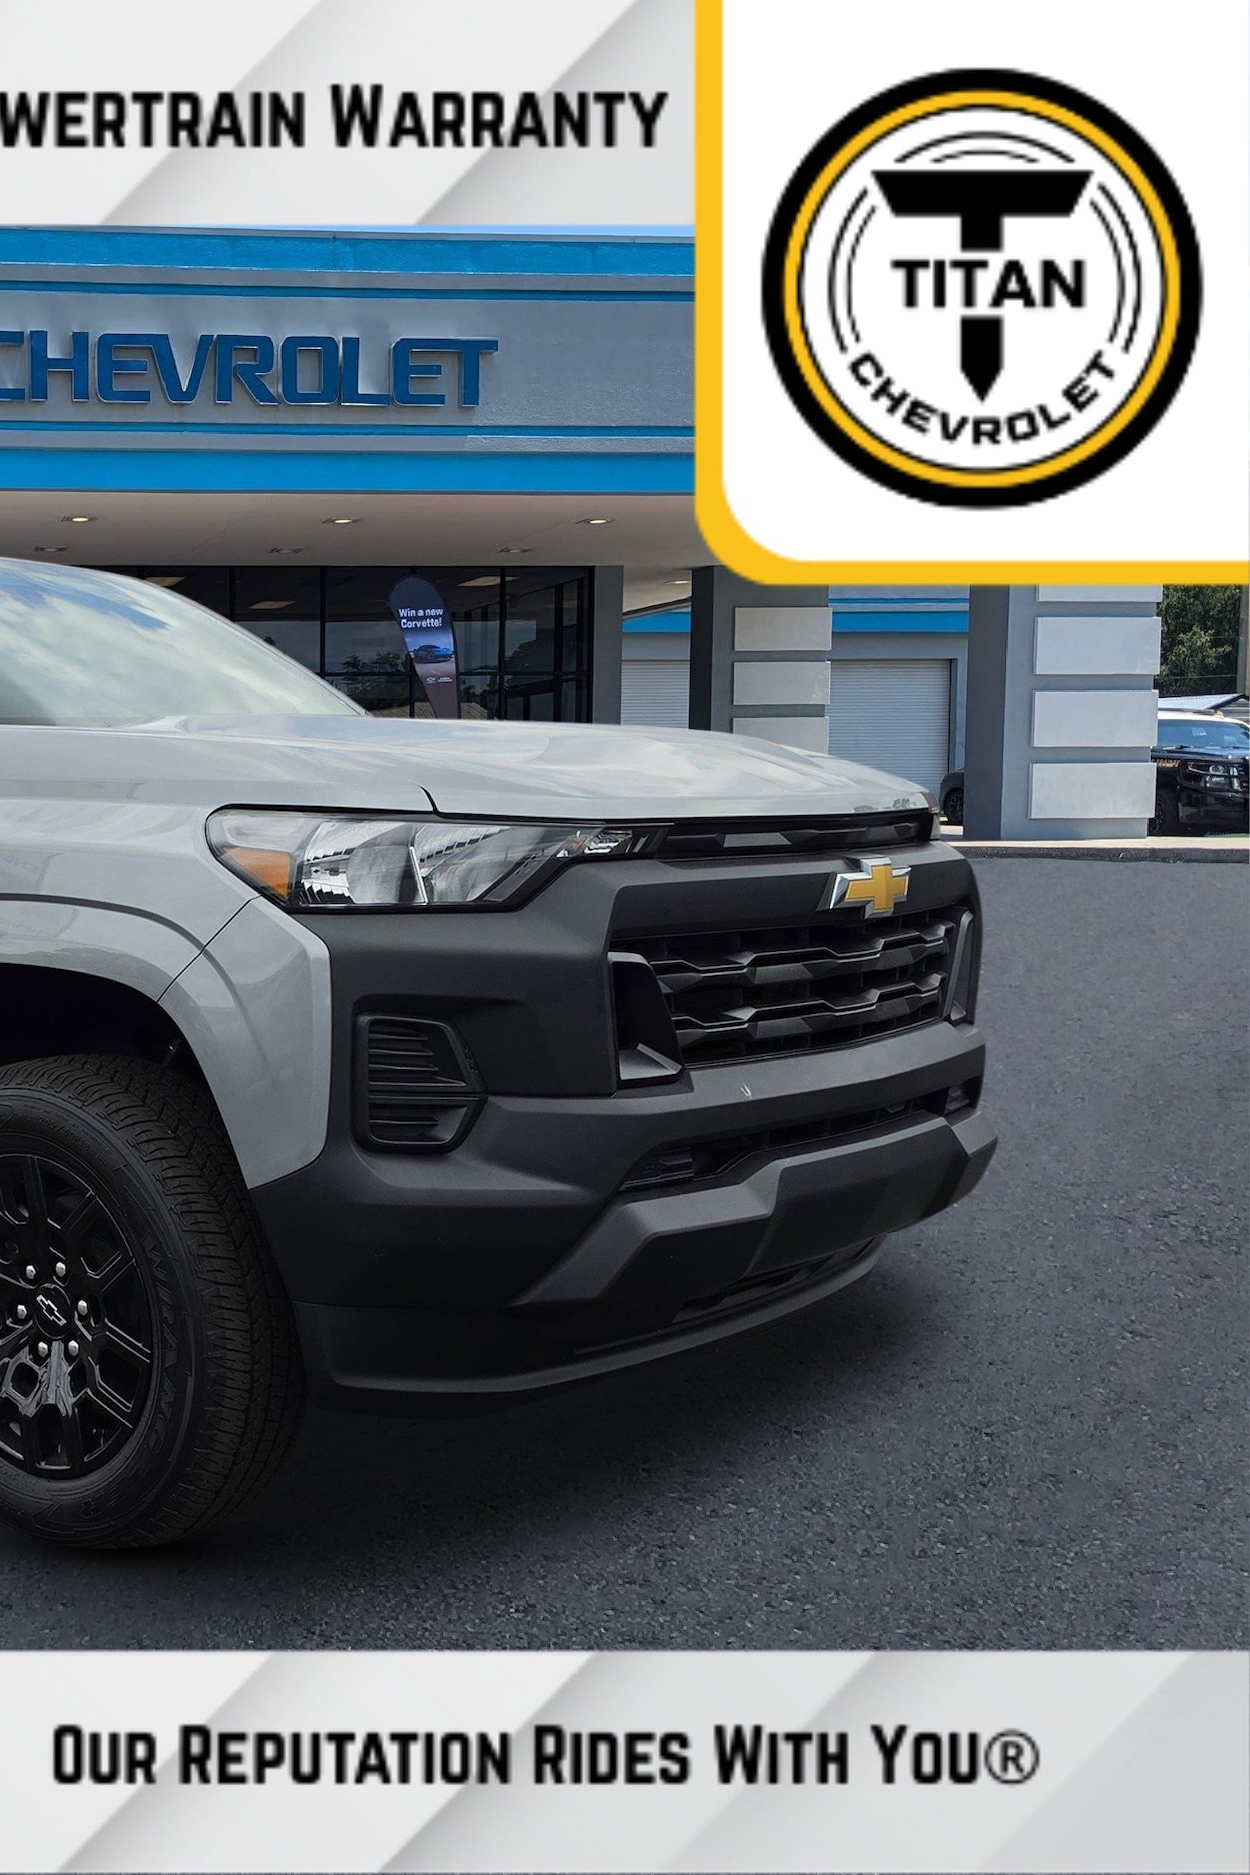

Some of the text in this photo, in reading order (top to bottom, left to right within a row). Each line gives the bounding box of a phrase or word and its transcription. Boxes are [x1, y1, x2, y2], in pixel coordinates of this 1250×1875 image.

[398, 607, 444, 617] Win a new
[400, 617, 442, 629] Corvette!
